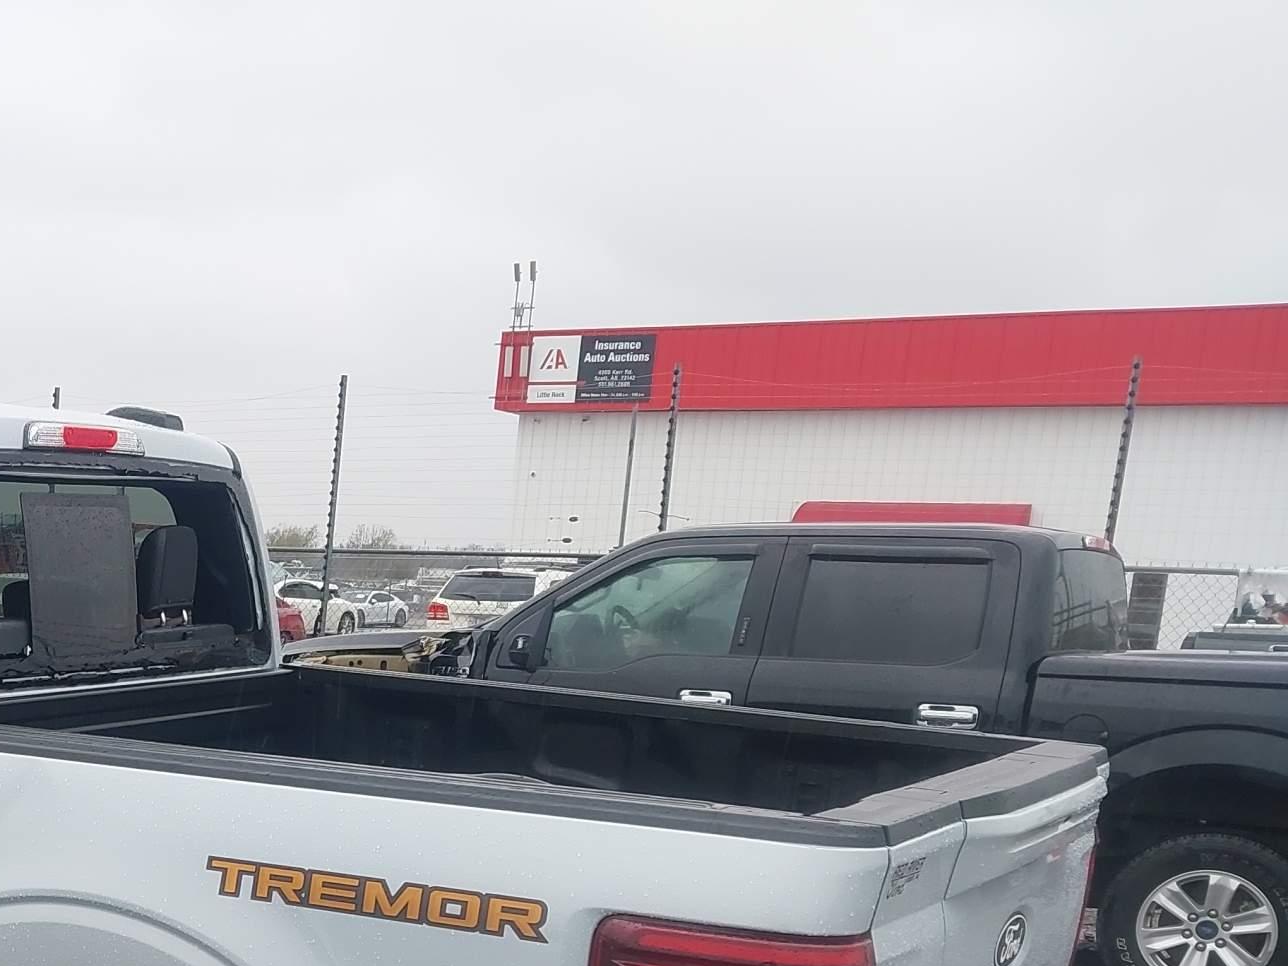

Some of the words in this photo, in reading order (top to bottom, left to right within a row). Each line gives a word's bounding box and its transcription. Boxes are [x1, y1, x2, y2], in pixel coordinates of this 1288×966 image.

[594, 339, 642, 351] Insurance
[583, 352, 606, 363] Auto
[607, 351, 650, 362] Auctions
[206, 855, 549, 944] TREMOR
